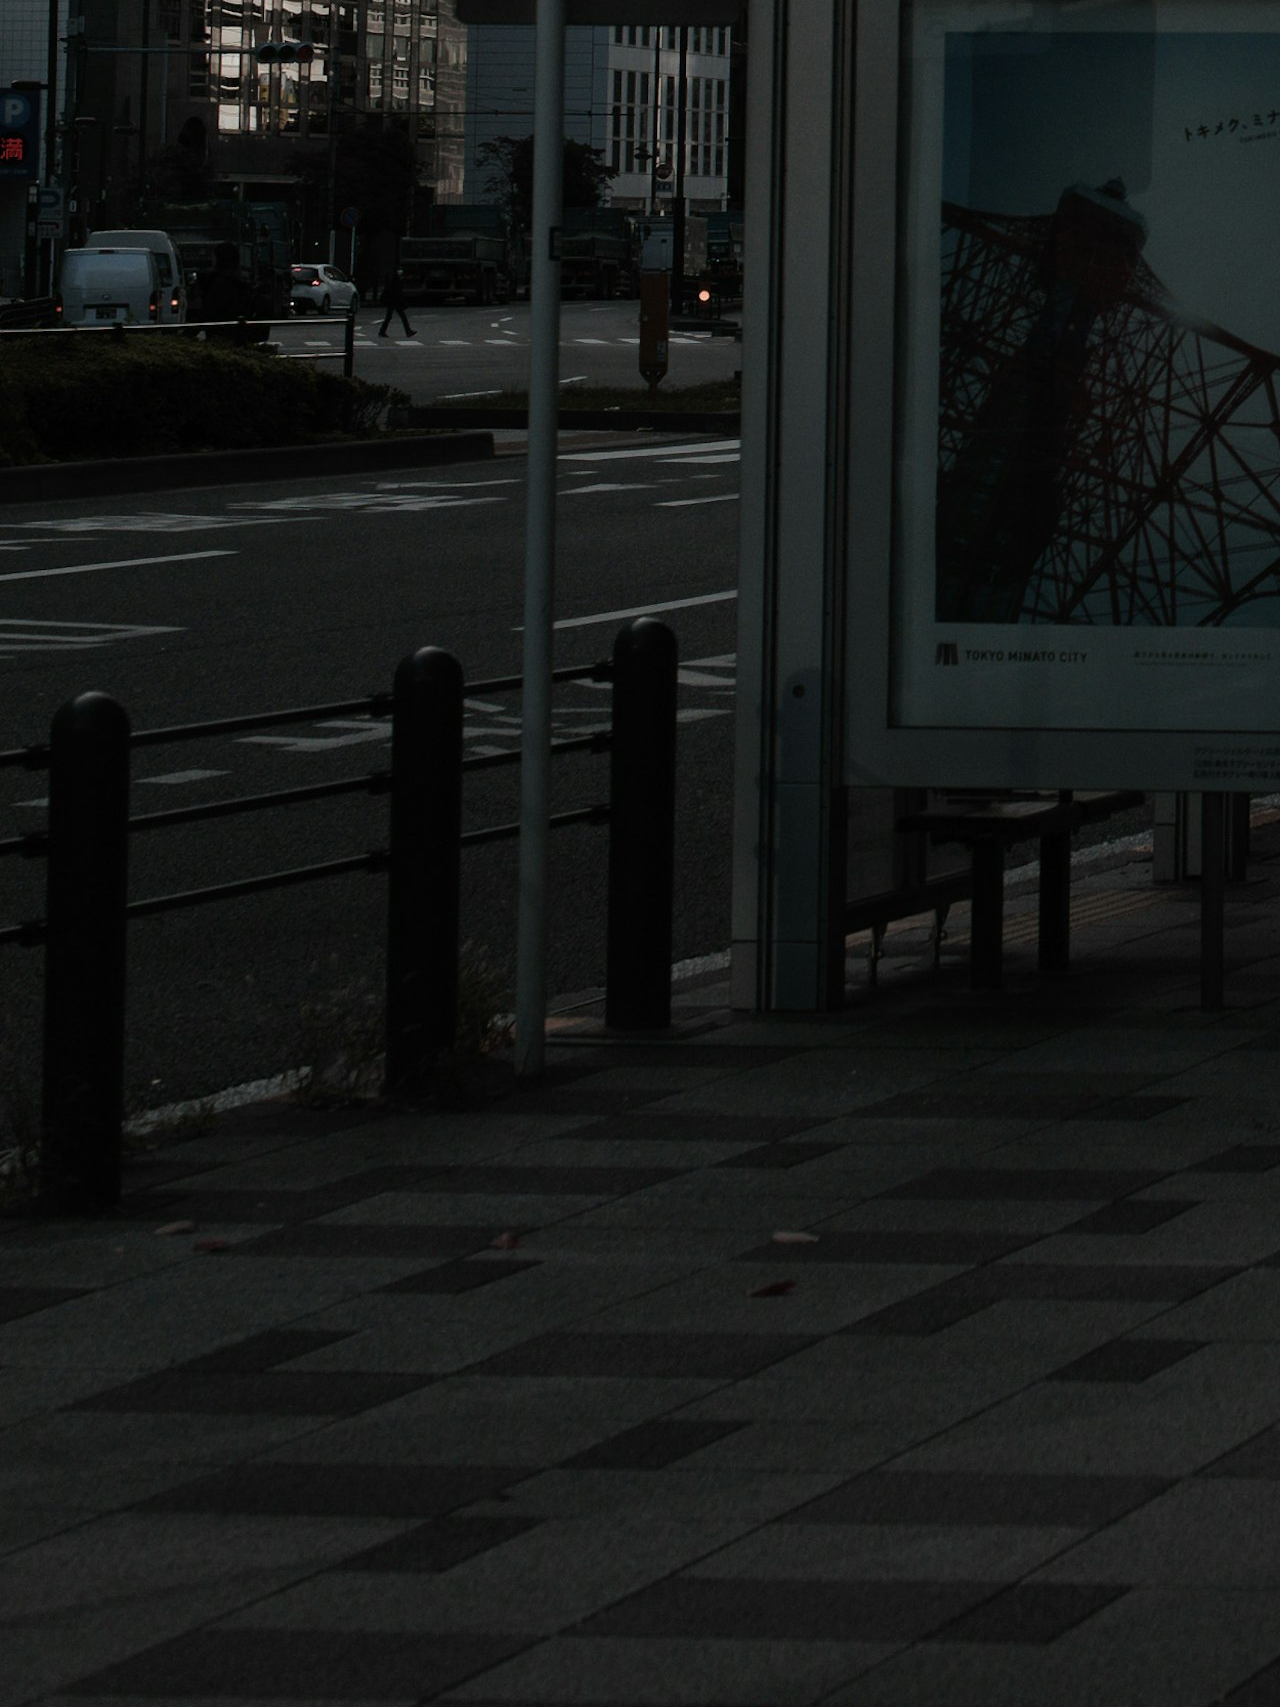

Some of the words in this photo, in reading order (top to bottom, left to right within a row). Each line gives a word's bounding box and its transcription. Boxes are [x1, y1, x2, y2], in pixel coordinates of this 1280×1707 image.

[4, 98, 25, 124] P
[965, 650, 1004, 662] TOKYO
[1008, 651, 1056, 663] MINATO
[1060, 652, 1088, 663] CITY
